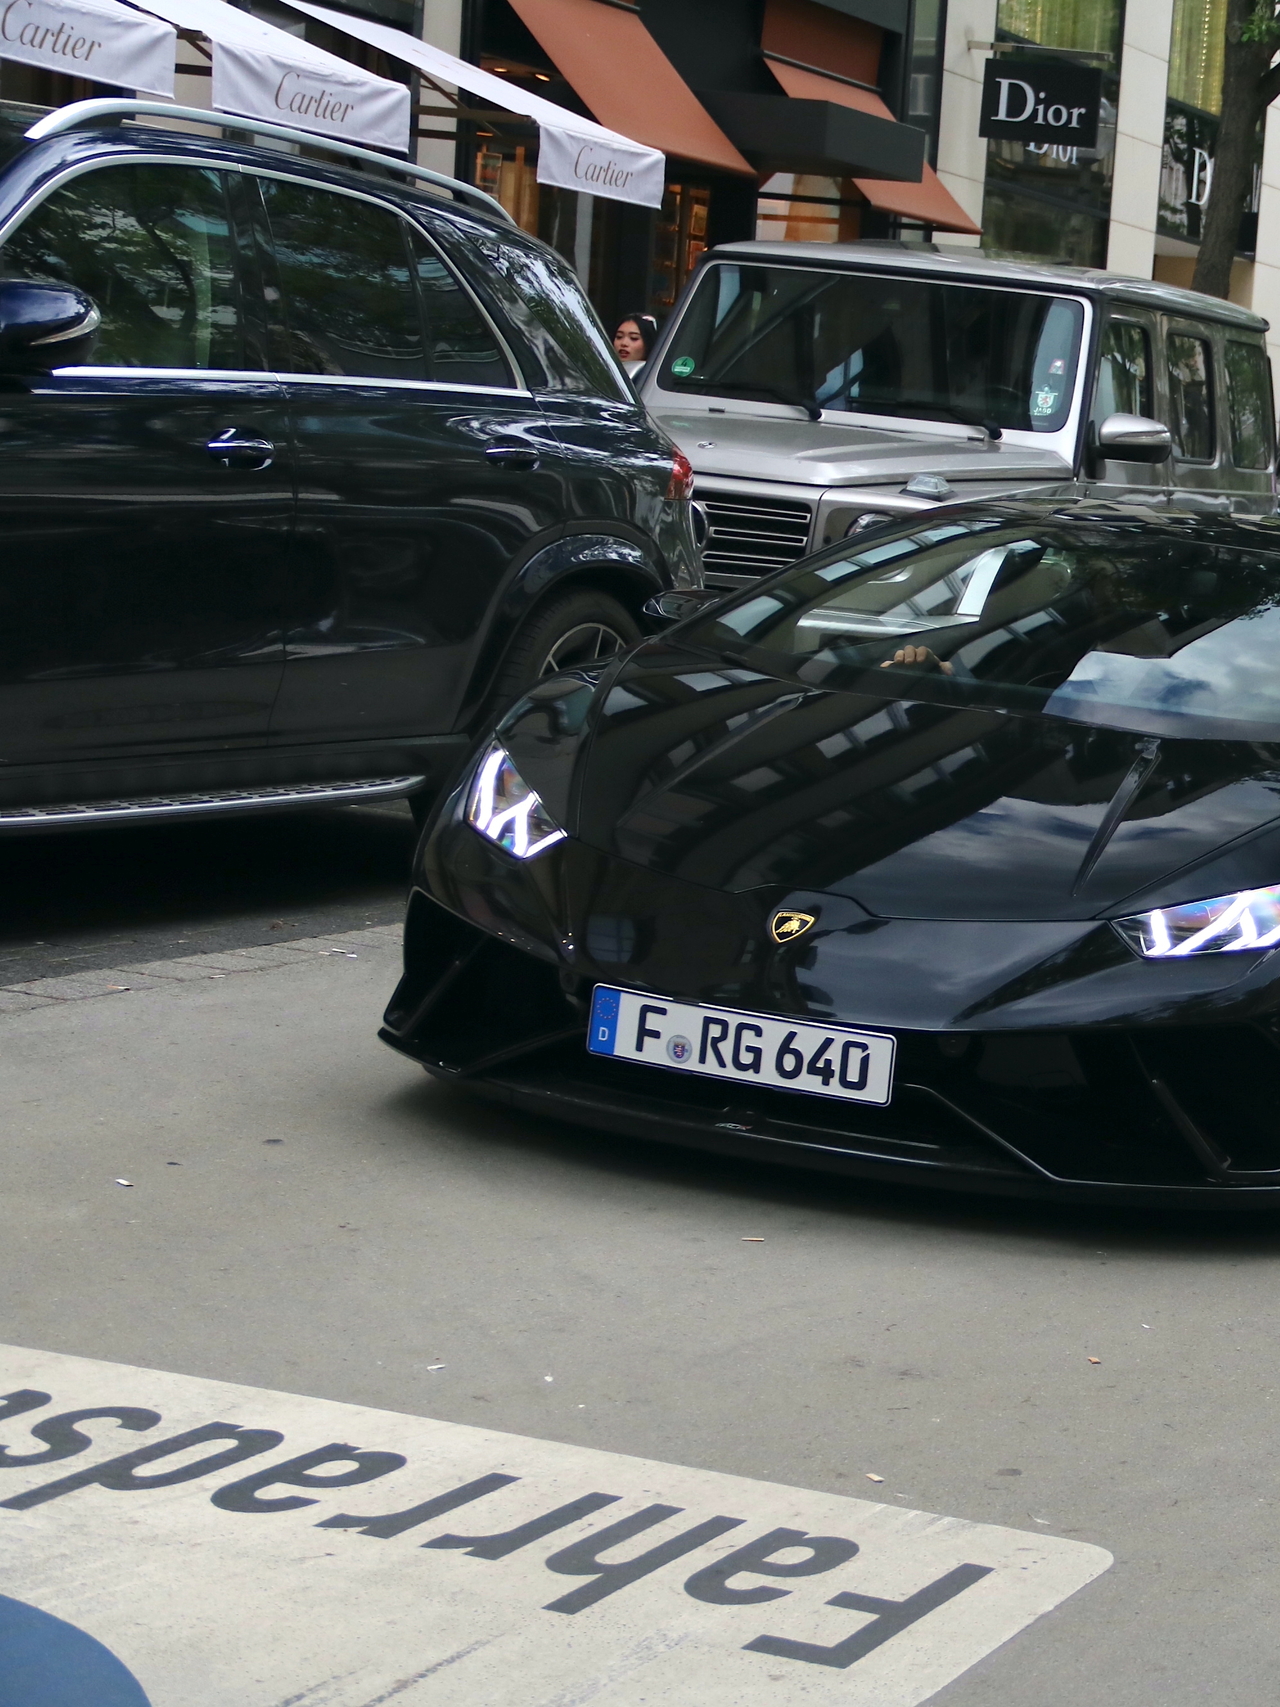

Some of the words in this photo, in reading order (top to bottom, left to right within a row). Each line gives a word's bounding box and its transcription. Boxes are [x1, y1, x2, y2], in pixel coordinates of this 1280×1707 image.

[1, 0, 102, 61] Cartier
[275, 71, 354, 122] Cartier
[991, 78, 1087, 128] Dior
[574, 145, 633, 188] Cartier
[598, 1027, 609, 1041] D
[635, 1003, 668, 1052] F
[698, 1015, 763, 1074] RG
[775, 1030, 871, 1091] 640
[0, 1388, 996, 1669] Fahrrads
